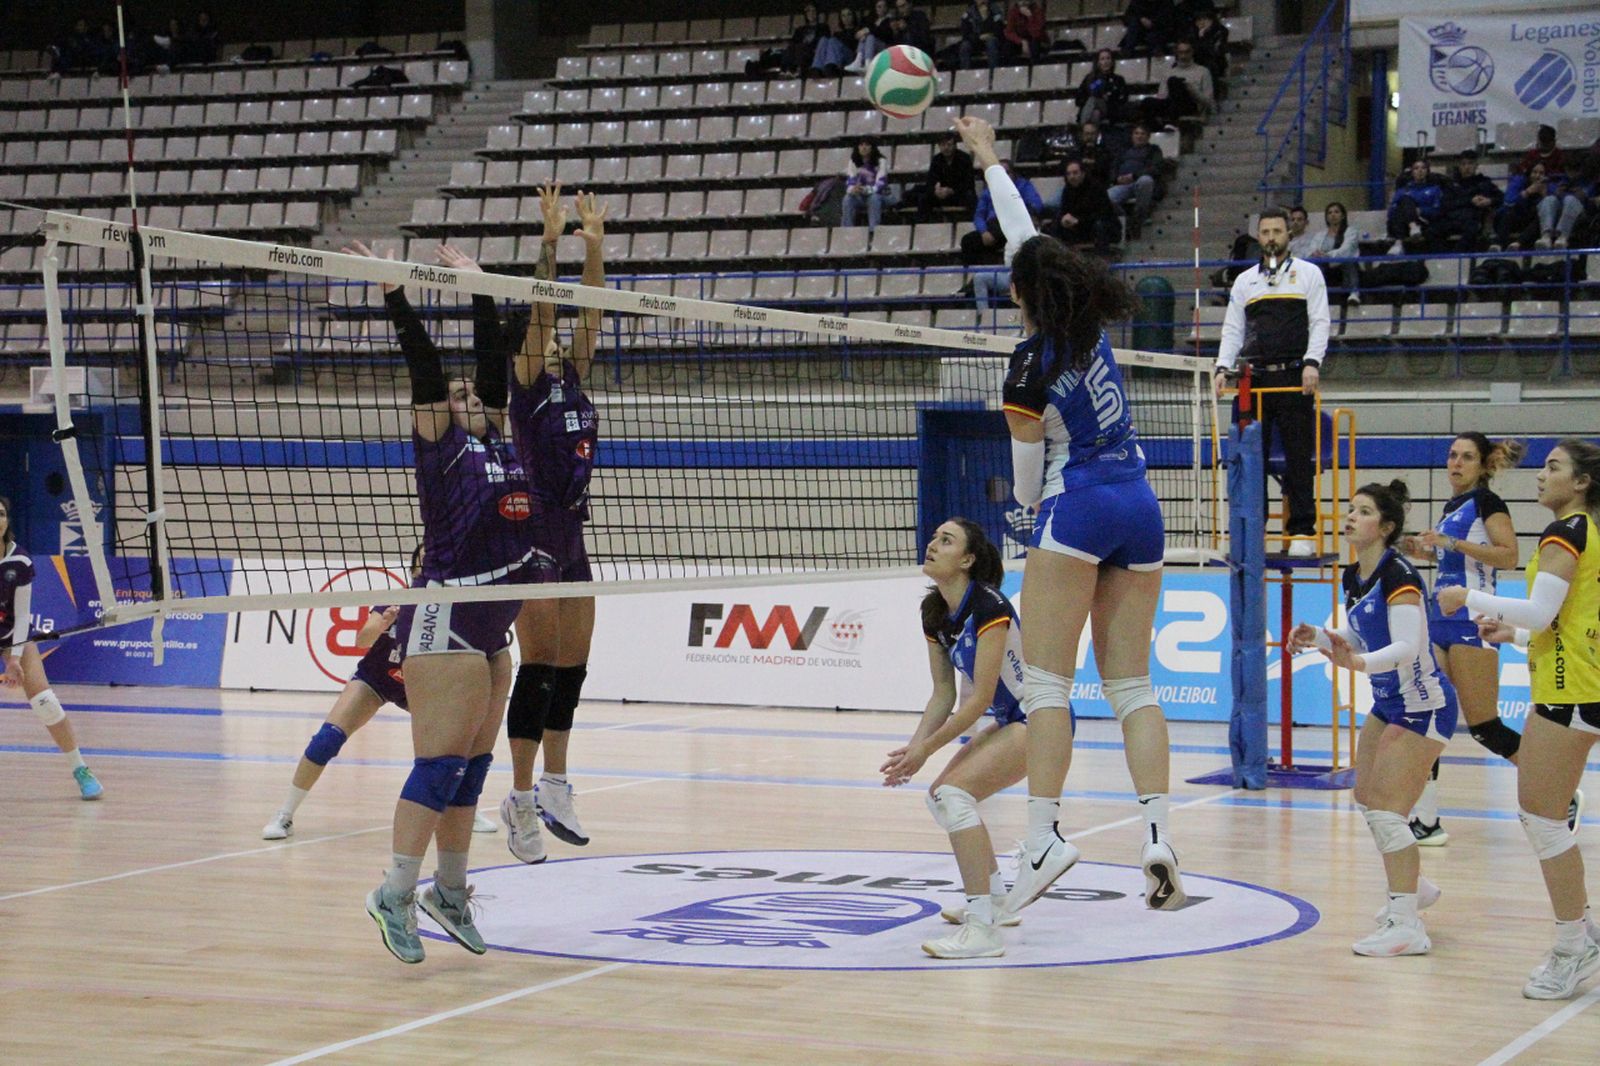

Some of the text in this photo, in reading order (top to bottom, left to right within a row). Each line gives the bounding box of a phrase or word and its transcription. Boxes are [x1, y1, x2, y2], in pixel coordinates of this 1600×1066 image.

[1510, 22, 1600, 43] Leganes
[268, 247, 324, 268] rfevb.com
[409, 267, 457, 285] rfevb.com
[531, 281, 574, 299] rfevb.com
[639, 294, 677, 312] rfevb.com
[733, 307, 767, 321] rfevb.com
[818, 315, 848, 331] rfevb.com
[1084, 356, 1123, 431] 5
[686, 653, 862, 668] FEDERACIÓN DE MADRID DE VOLEIBOL
[1153, 684, 1217, 704] VOLEIBOL
